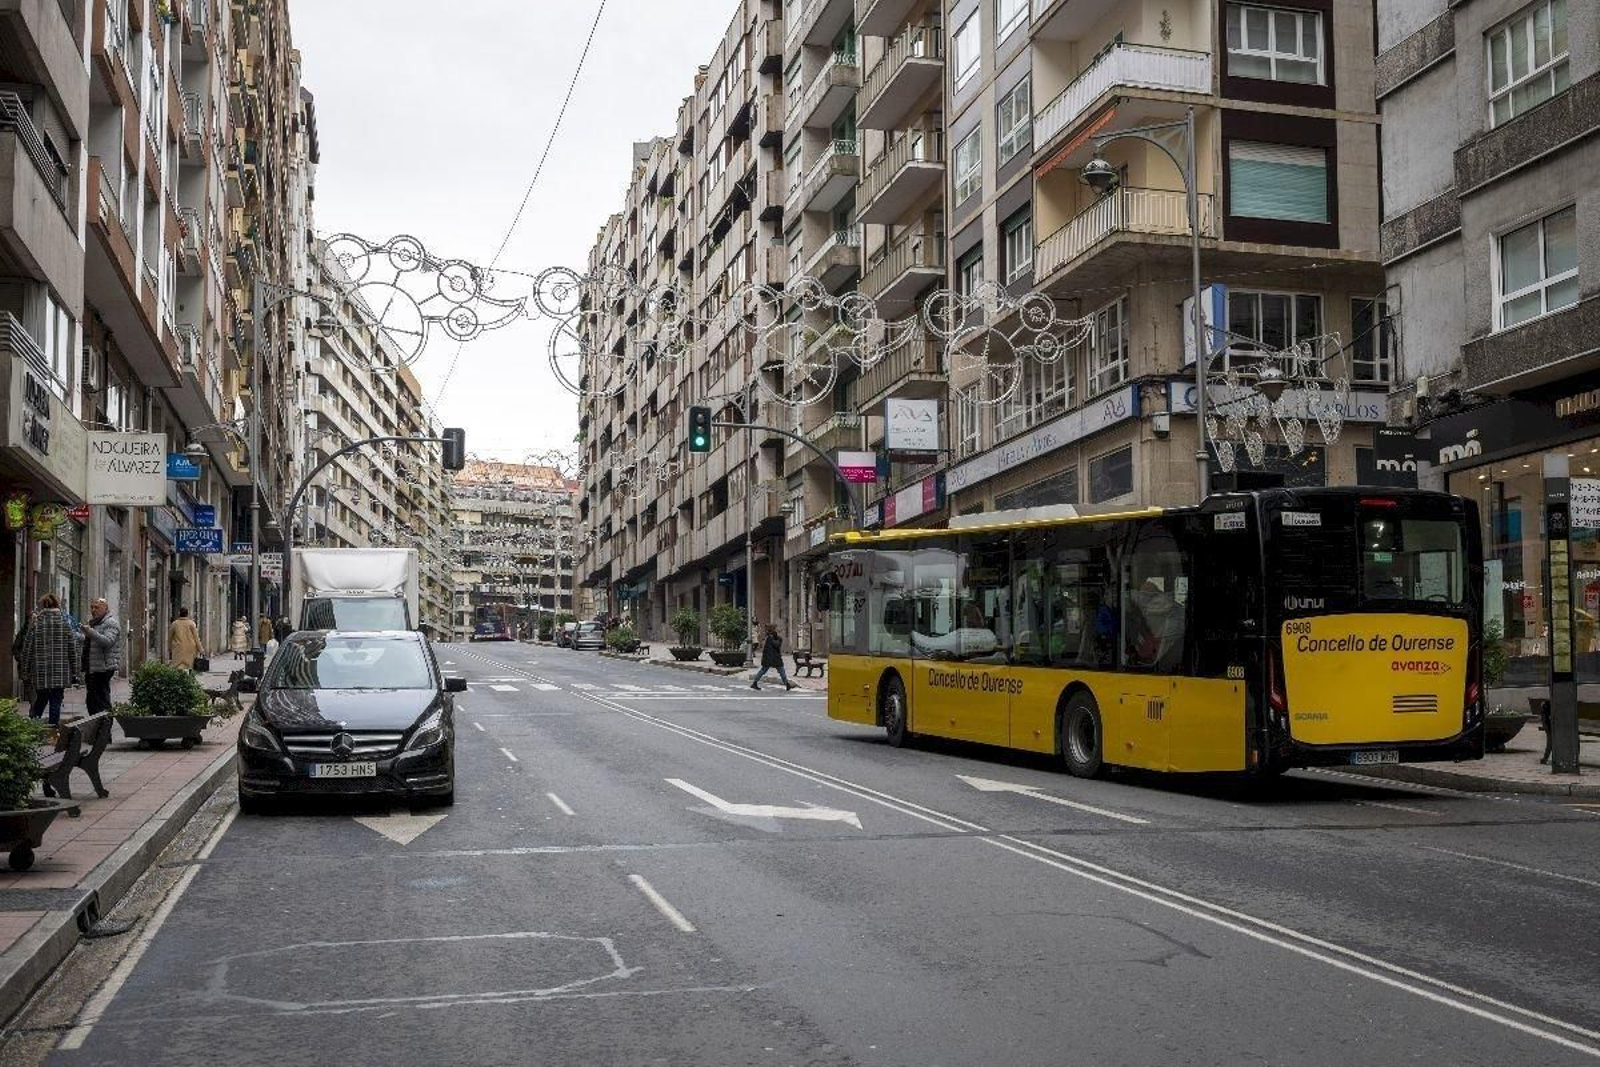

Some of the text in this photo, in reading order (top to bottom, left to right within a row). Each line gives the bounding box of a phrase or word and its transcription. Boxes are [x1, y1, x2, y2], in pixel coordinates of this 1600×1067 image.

[107, 458, 161, 474] ÁLVAREZ
[1285, 622, 1312, 635] 6908
[1297, 634, 1454, 652] Concello de Ourense
[1391, 660, 1440, 671] avanza
[928, 668, 1023, 694] Concello de Ourense
[320, 765, 347, 776] 1753
